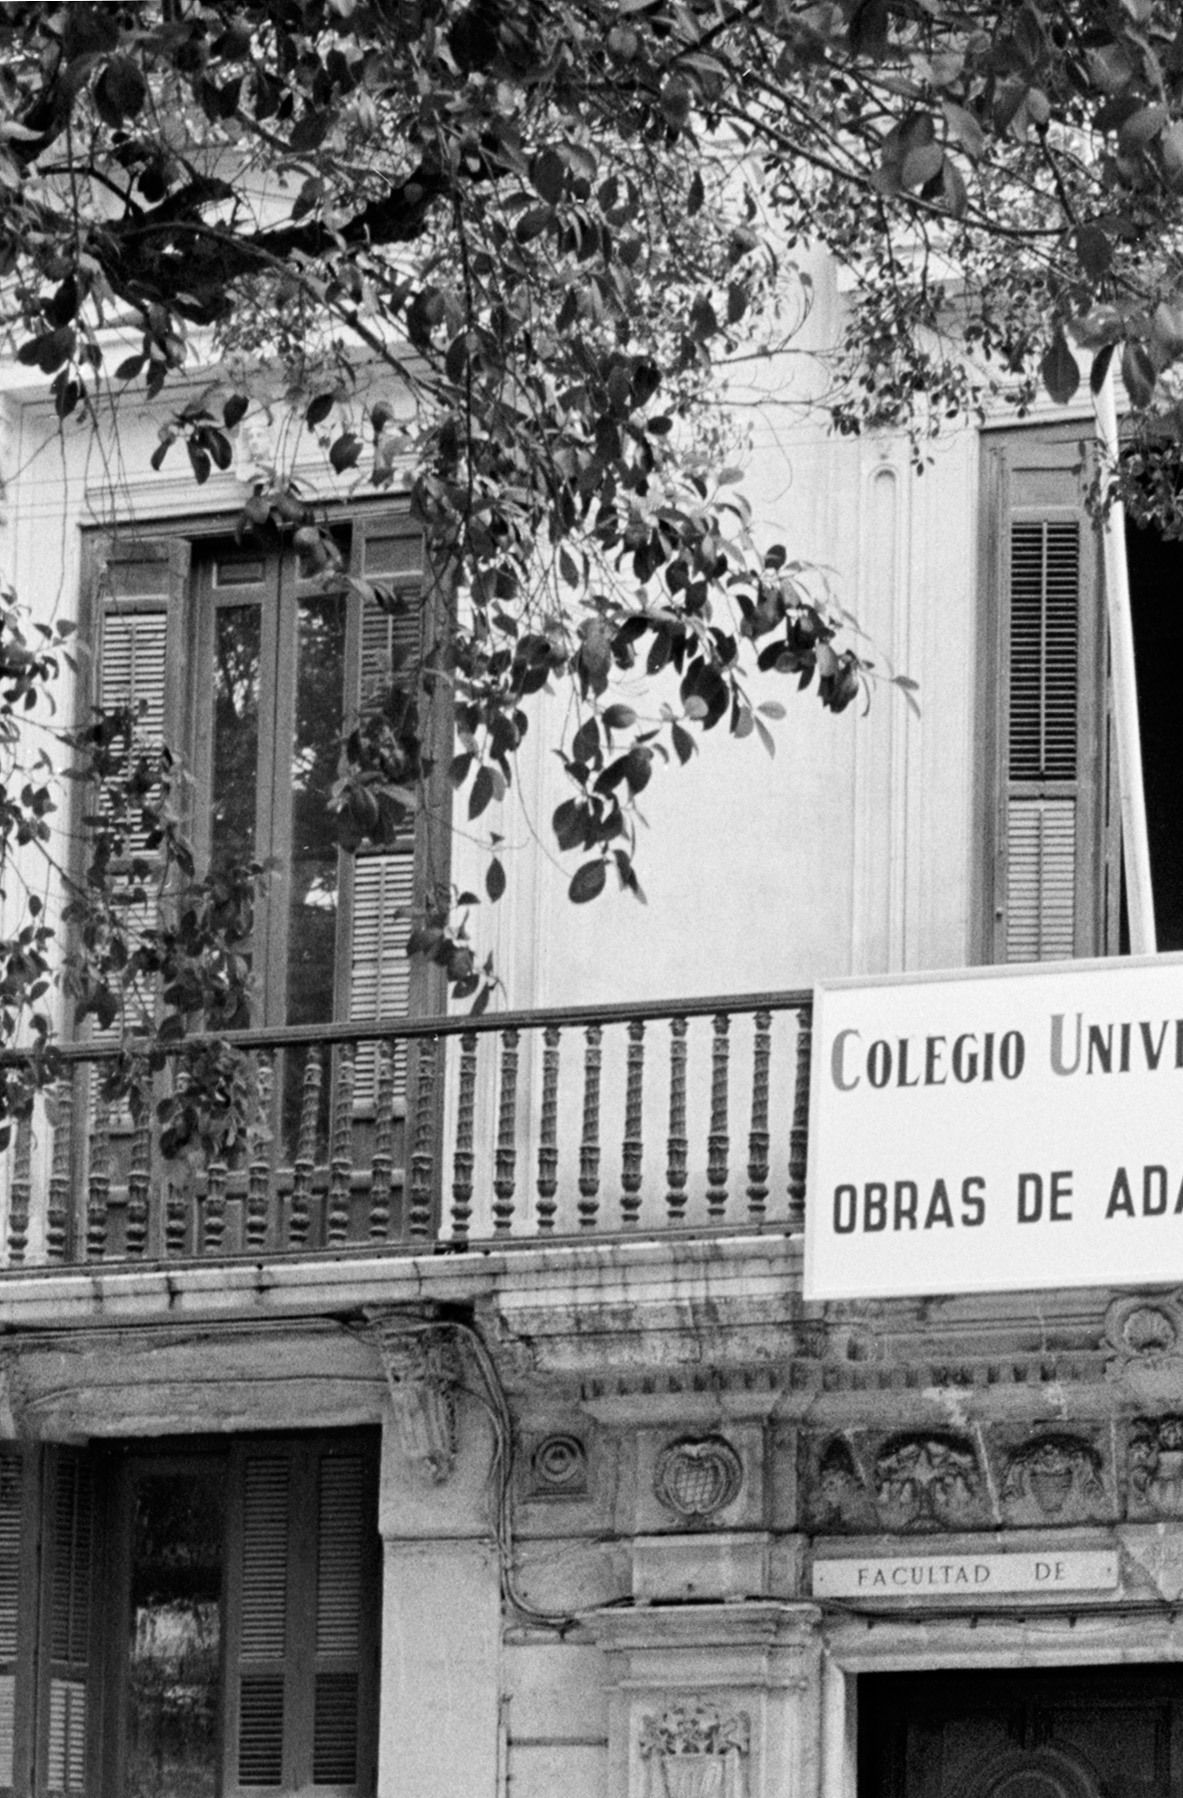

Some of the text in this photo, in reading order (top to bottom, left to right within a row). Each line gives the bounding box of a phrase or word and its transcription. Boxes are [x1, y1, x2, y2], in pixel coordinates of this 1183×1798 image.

[831, 1028, 1025, 1091] COLEGIO
[832, 1176, 987, 1235] OBRAS
[1017, 1170, 1074, 1224] DE
[857, 1561, 1065, 1587] FACULTAD DE
